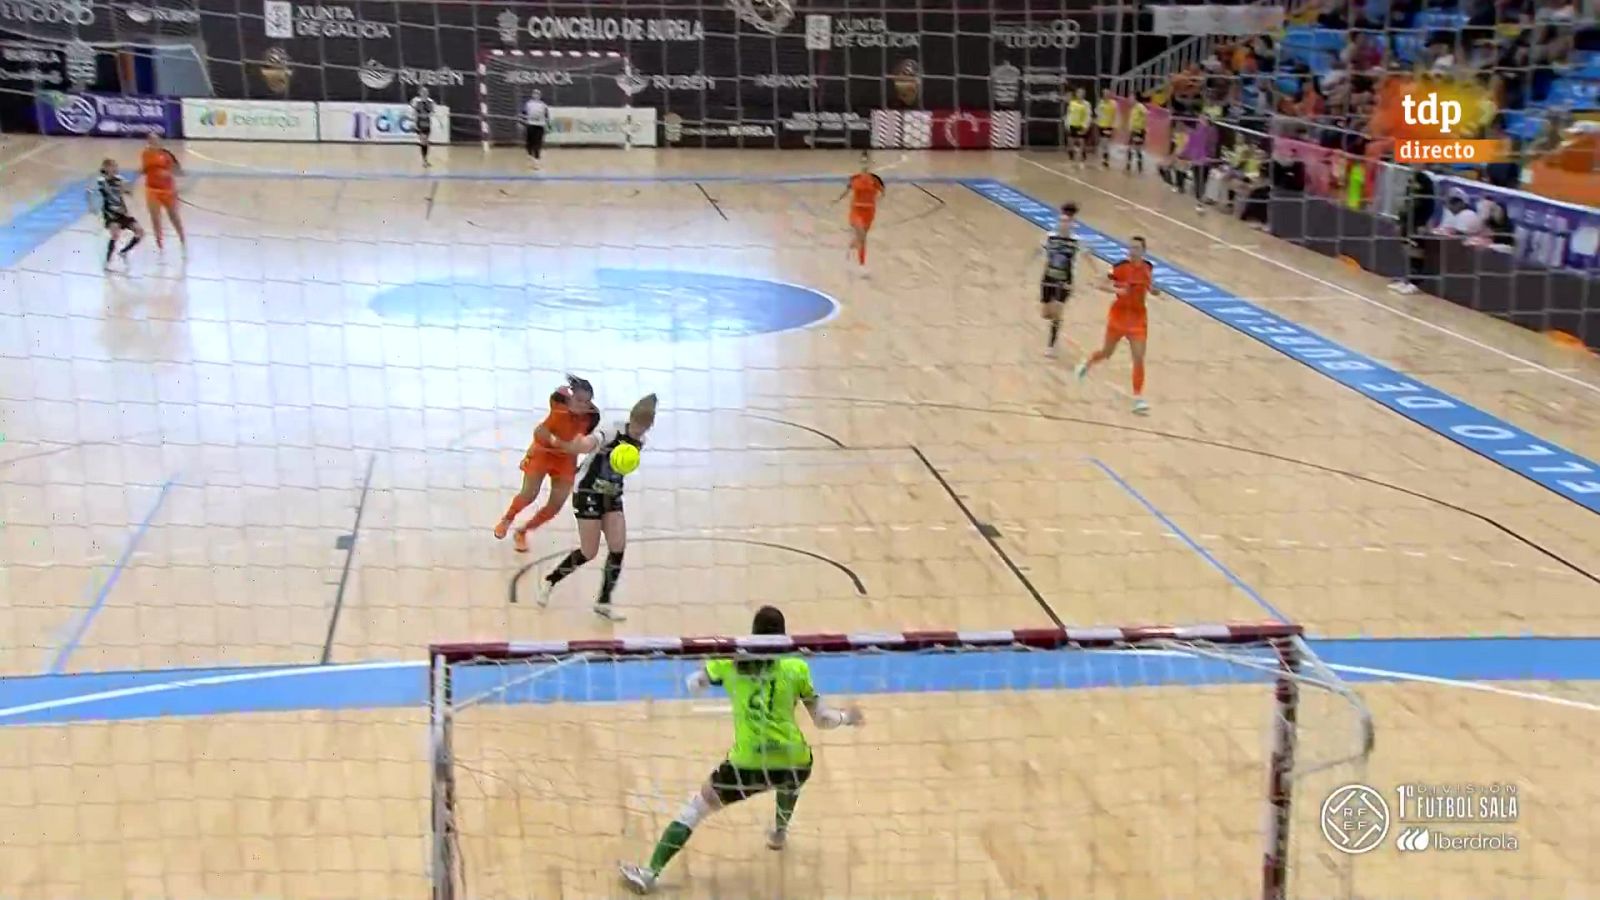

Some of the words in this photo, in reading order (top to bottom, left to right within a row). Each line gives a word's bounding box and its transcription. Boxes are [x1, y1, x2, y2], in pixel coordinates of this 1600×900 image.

[297, 5, 355, 20] XUNTA
[297, 20, 321, 36] DE
[527, 16, 616, 41] CONCELLO
[620, 18, 645, 41] DE
[649, 19, 705, 42] BURELA
